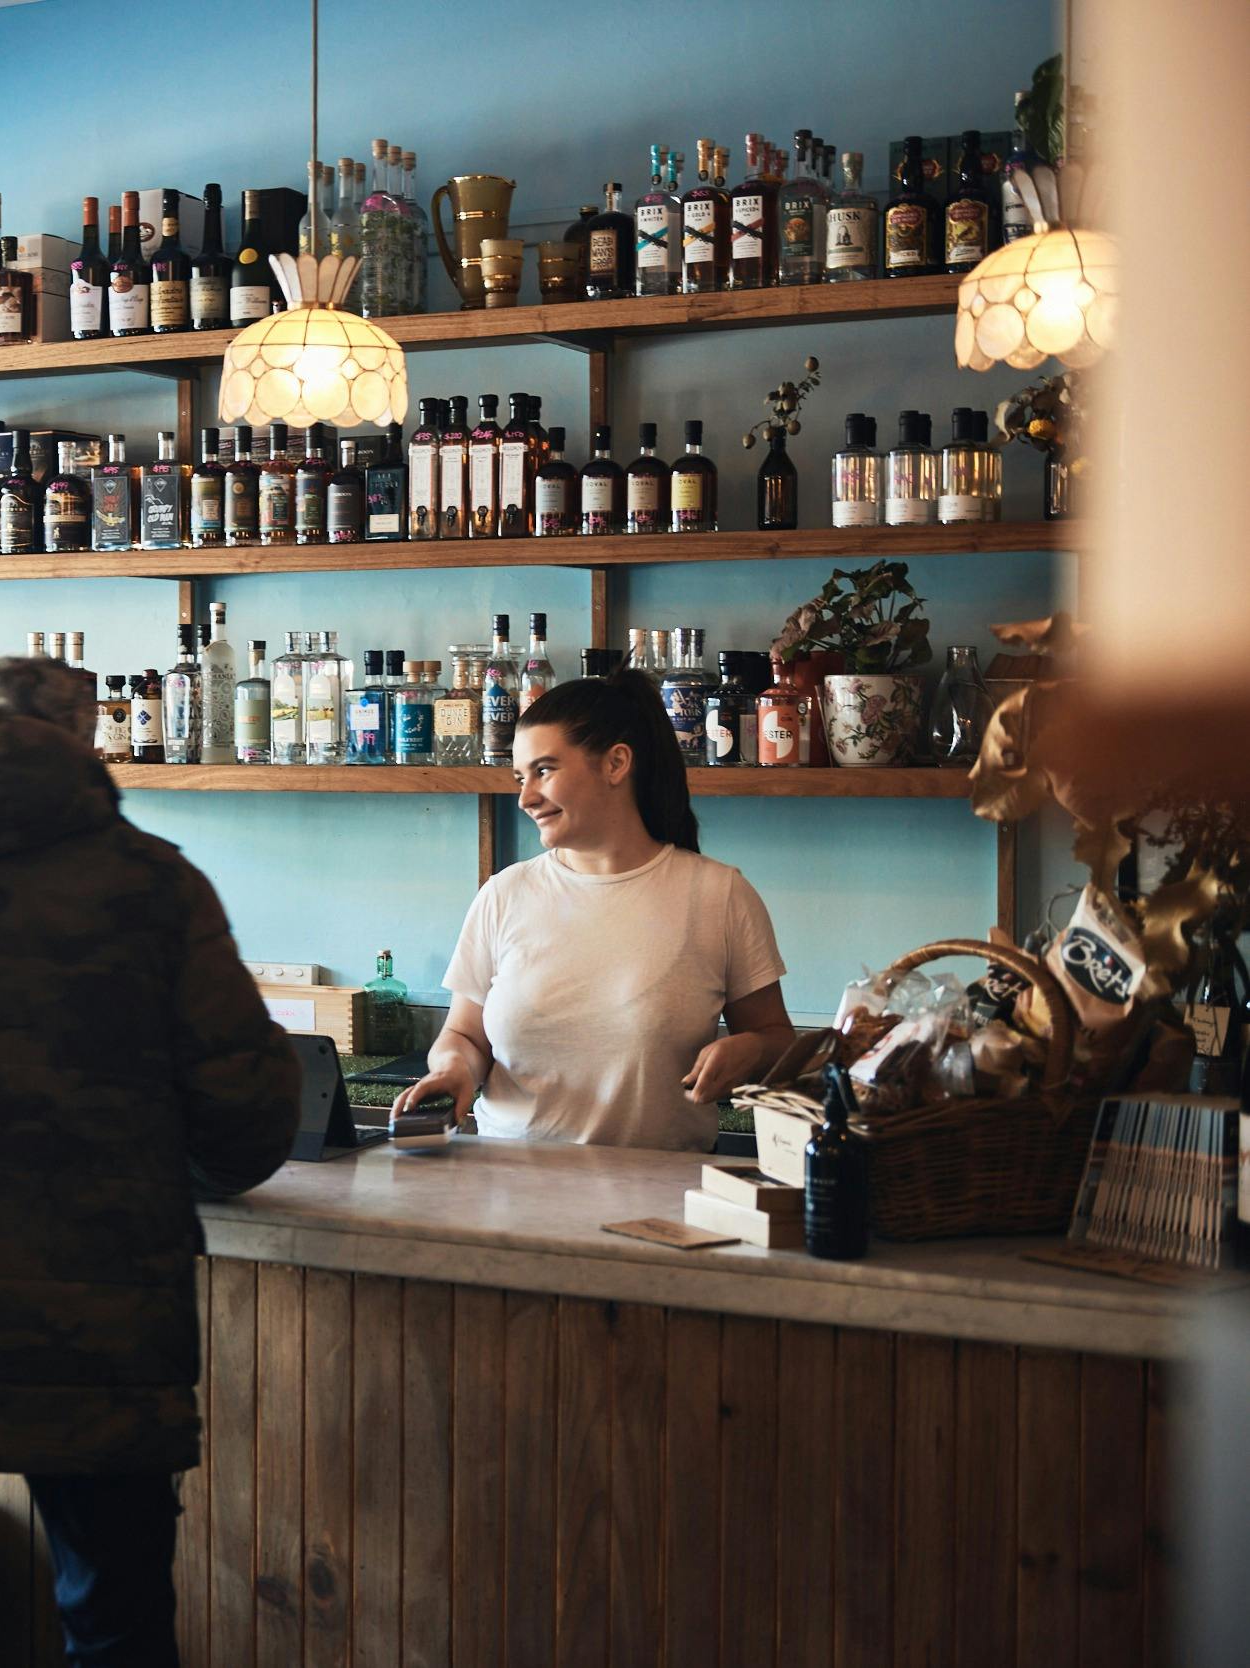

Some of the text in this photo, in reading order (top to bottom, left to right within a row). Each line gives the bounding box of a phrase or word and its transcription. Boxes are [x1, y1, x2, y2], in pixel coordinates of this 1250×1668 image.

[687, 203, 710, 212] BRIX
[735, 198, 759, 207] BRIX
[784, 201, 810, 211] BRIX
[640, 208, 663, 216] BRIX
[829, 211, 861, 223] HUSK
[485, 695, 516, 707] EVER
[485, 711, 516, 723] EVER
